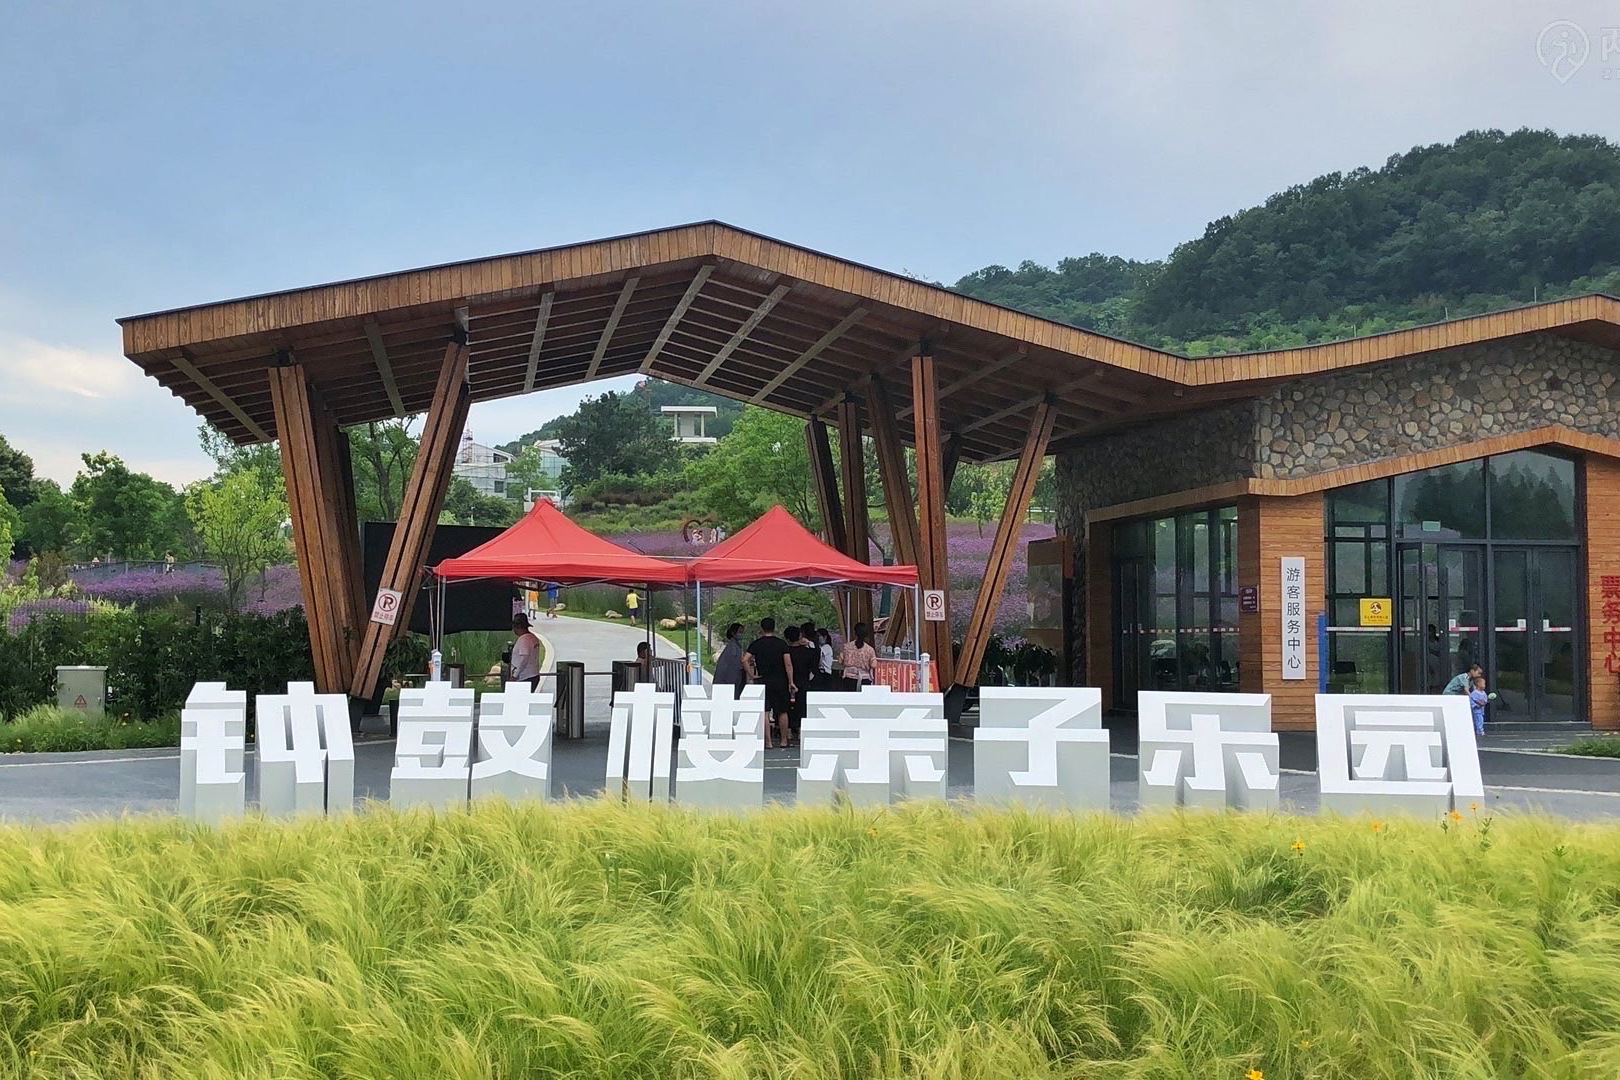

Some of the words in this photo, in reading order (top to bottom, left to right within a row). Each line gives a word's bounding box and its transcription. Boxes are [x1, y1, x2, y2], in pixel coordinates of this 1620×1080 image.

[1286, 567, 1301, 669] 游客服务中心
[1601, 575, 1620, 673] 票务中心
